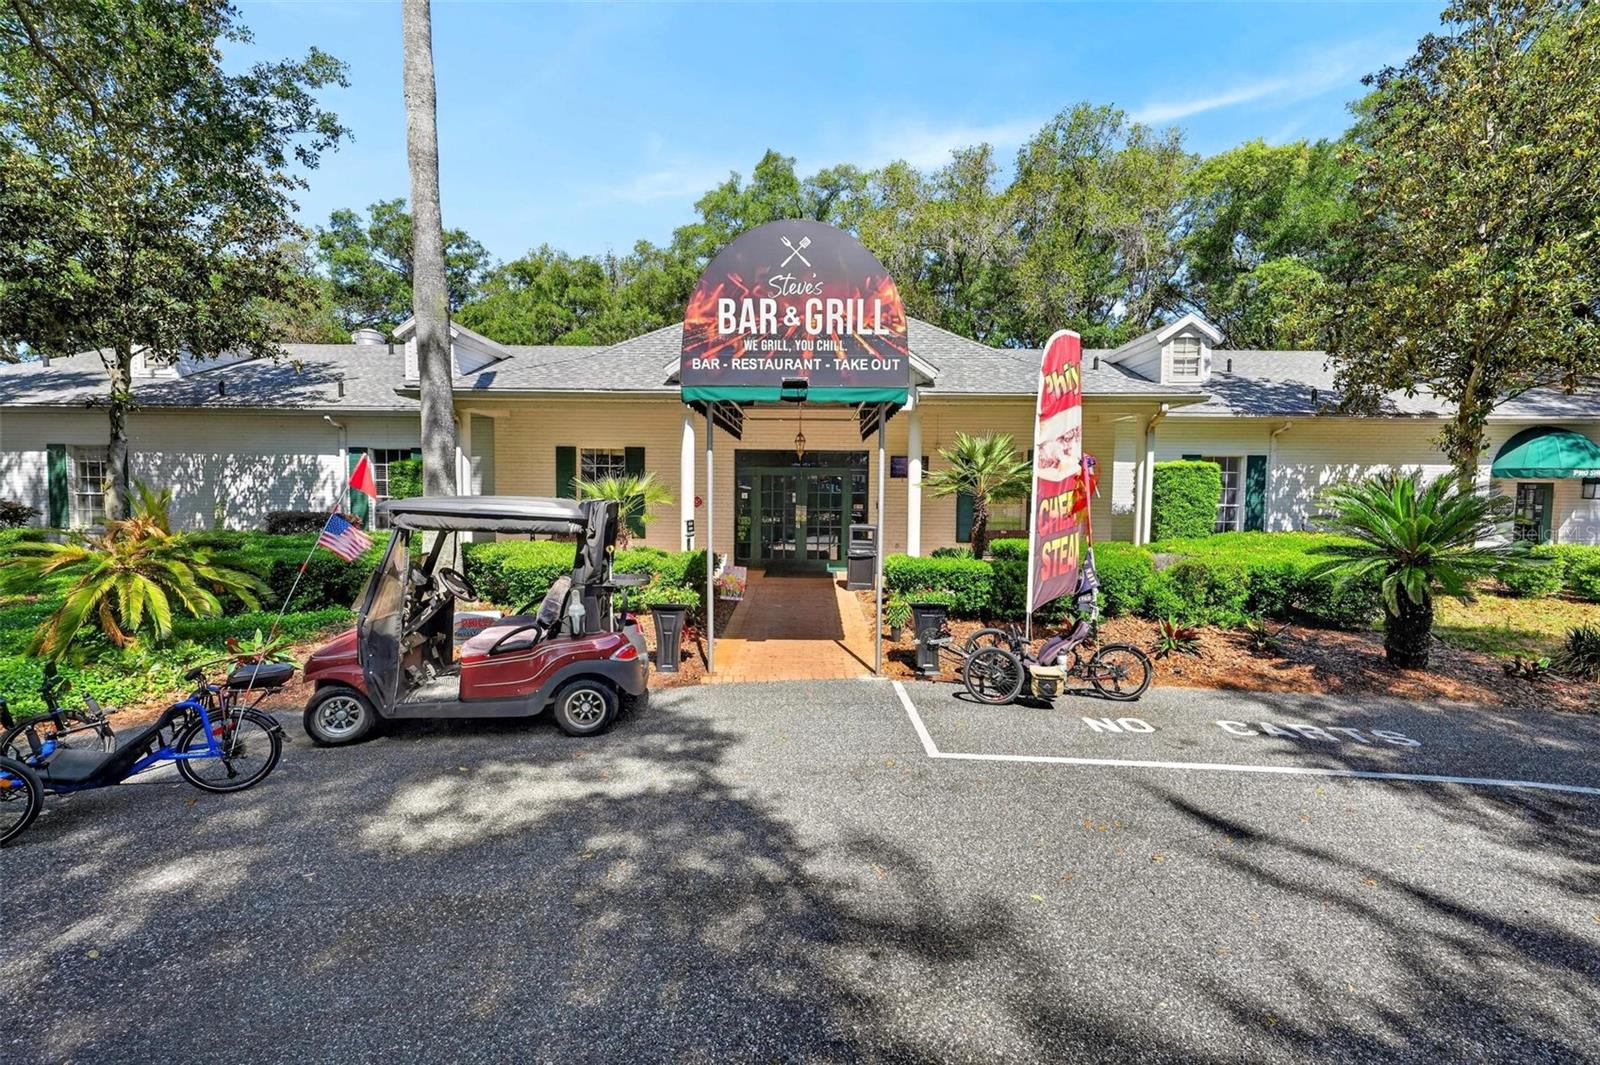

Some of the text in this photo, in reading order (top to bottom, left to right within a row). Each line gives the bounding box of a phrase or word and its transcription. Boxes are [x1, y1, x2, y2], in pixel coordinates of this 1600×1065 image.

[768, 273, 824, 299] Steve's
[718, 298, 890, 335] BAR & GRILL
[743, 339, 848, 353] WE GRILL, YOU CHILL.
[692, 358, 720, 370] BAR
[731, 358, 822, 371] RESTAURANT
[833, 359, 868, 371] TAKE
[871, 359, 900, 371] OUT
[1082, 716, 1422, 747] NO CARTS
